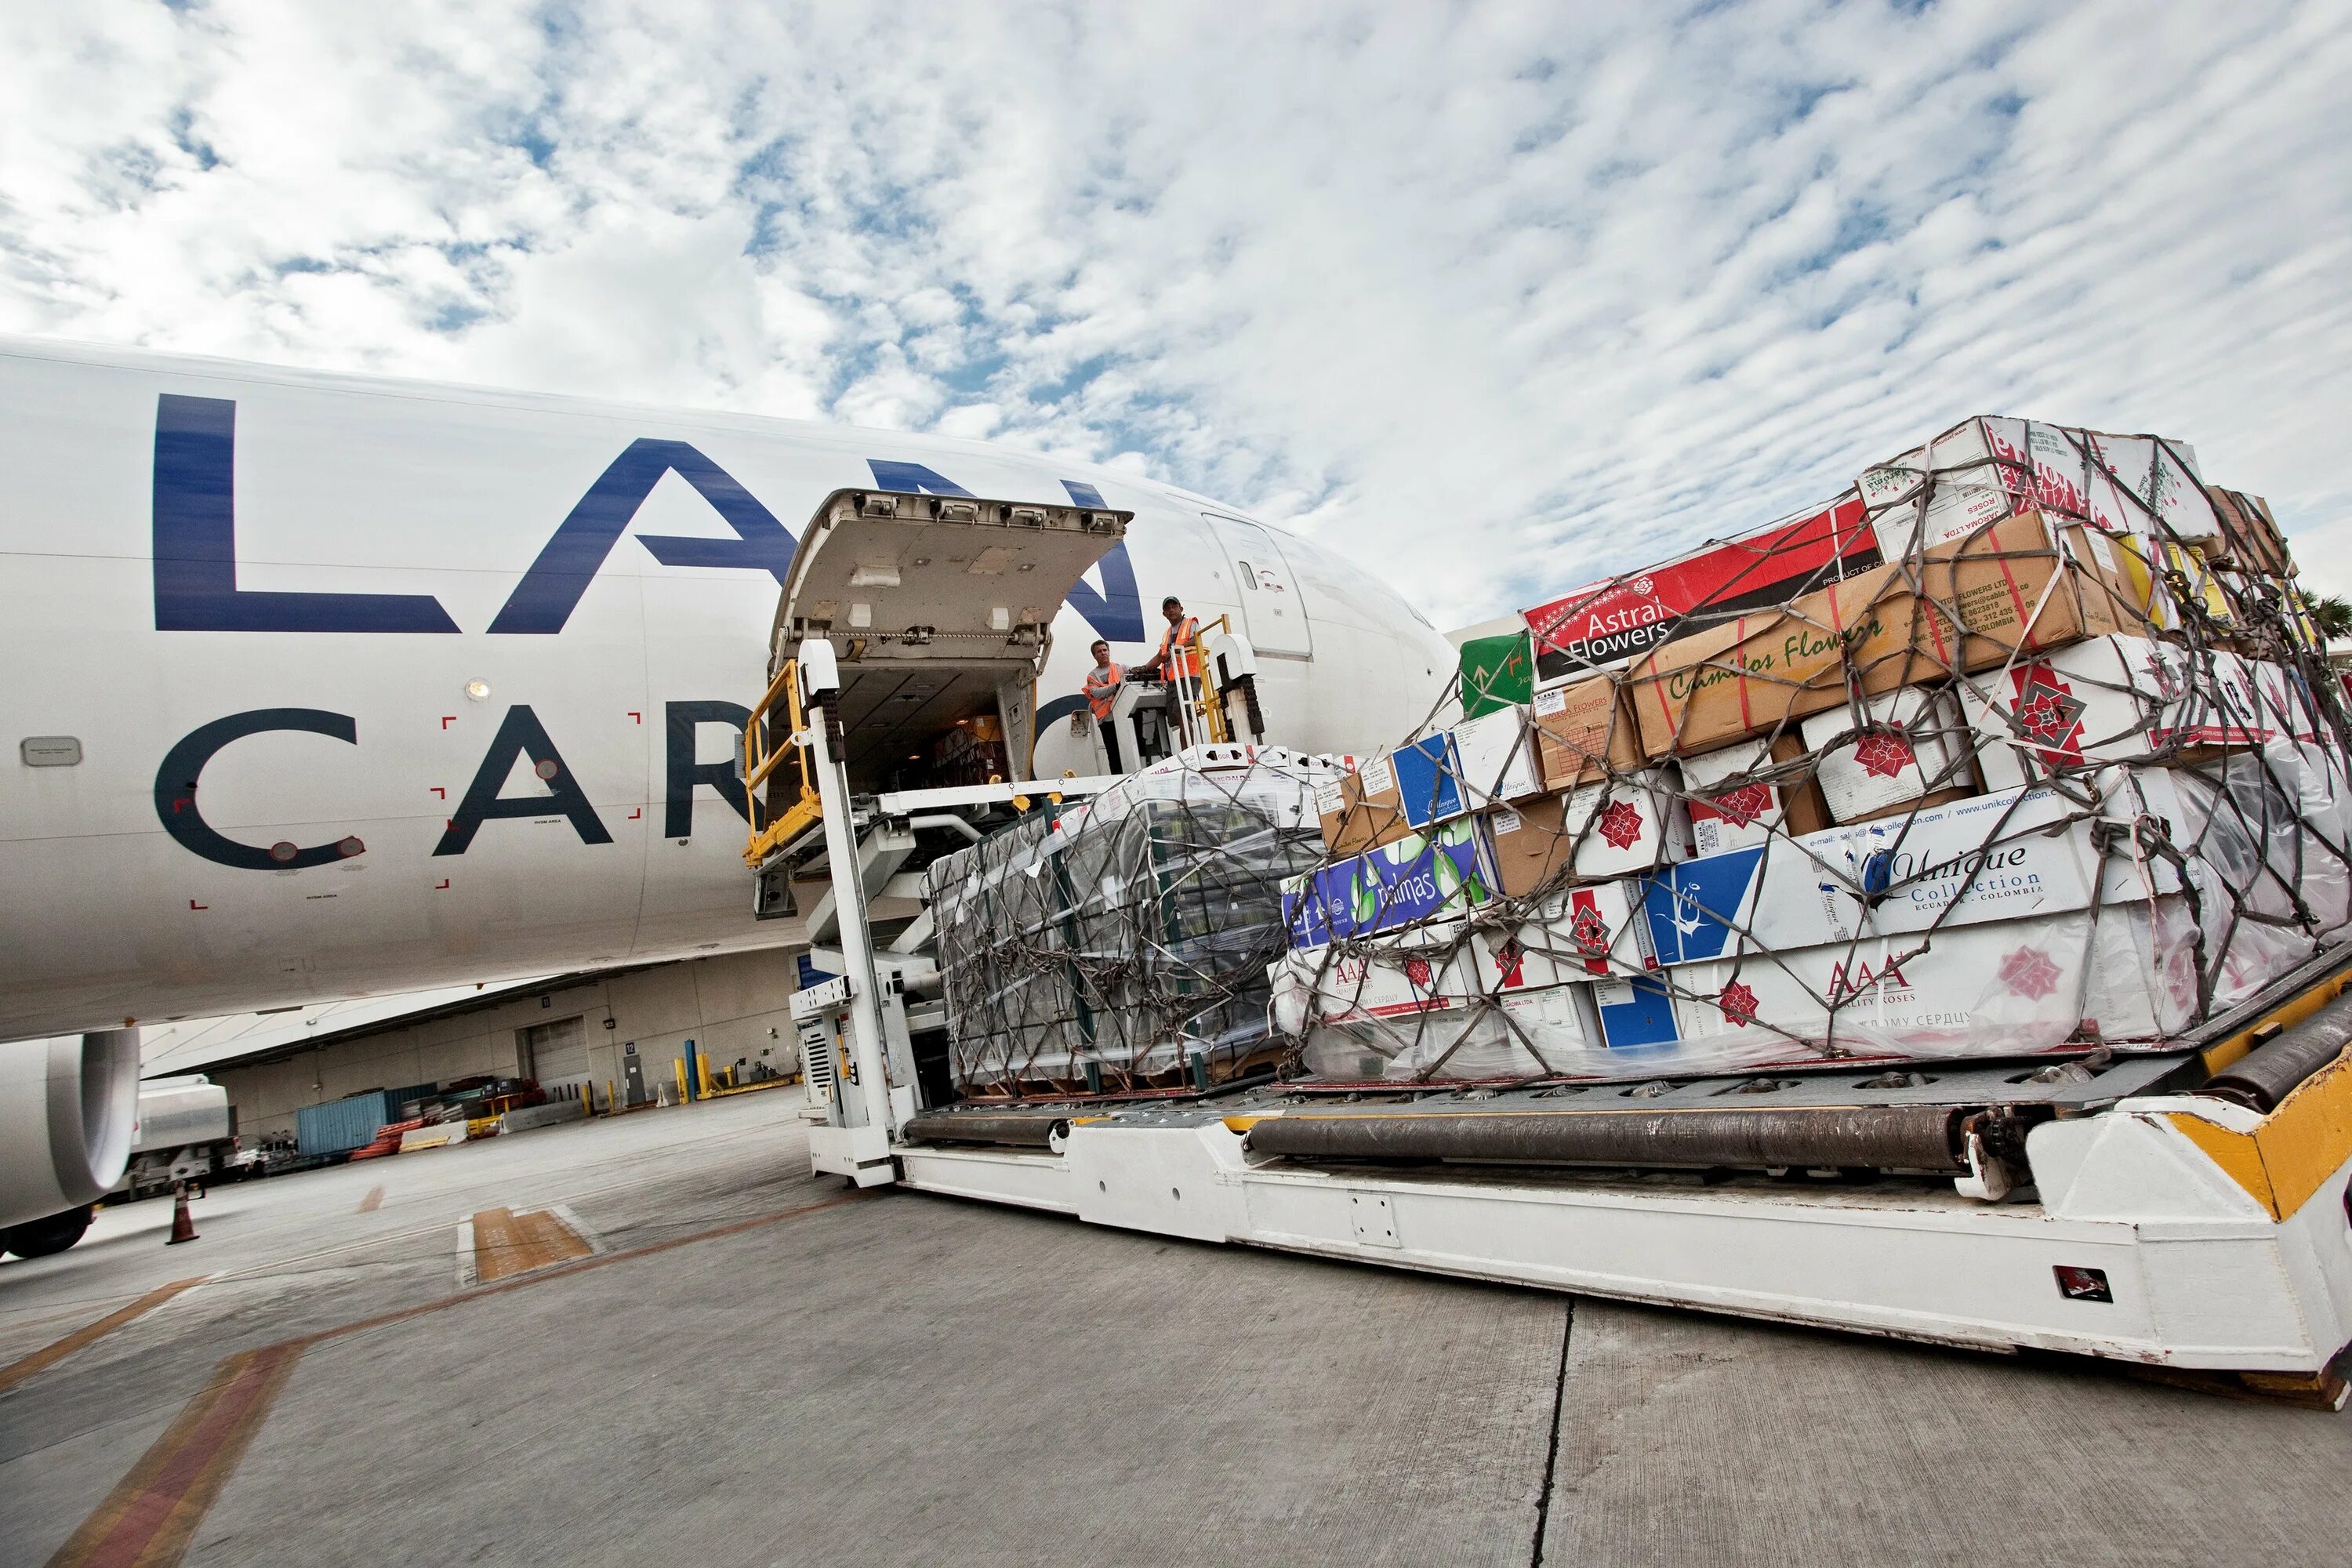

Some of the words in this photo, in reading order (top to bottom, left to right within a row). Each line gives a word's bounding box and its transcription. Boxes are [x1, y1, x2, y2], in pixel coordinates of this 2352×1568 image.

[1967, 498, 1996, 514] ROSES
[1965, 511, 2000, 530] JAROMA
[1823, 567, 1861, 586] PROUCT
[1861, 564, 1873, 573] OF
[1958, 583, 1994, 601] FLOWERS
[1588, 596, 1664, 639] Astral
[1968, 601, 2000, 617] 8623818
[1984, 611, 1998, 621] 312
[1999, 607, 2014, 618] 435
[1976, 616, 2016, 634] COLOMBIA
[1568, 621, 1668, 661] Flowers
[1548, 709, 1573, 720] MEGA
[1573, 696, 1608, 713] FLOWERS
[1955, 789, 2056, 816] www.unikcollction.c
[1809, 835, 1836, 848] e-mail:
[1893, 847, 2027, 887] Unique
[1377, 872, 1436, 909] palmas
[1627, 883, 1639, 916] CLOMBIA
[1915, 896, 1965, 912] ECUADR
[1980, 885, 2045, 902] COLOMBIA
[1374, 994, 1399, 1004] СЕРДЦУ
[626, 1044, 634, 1054] 12
